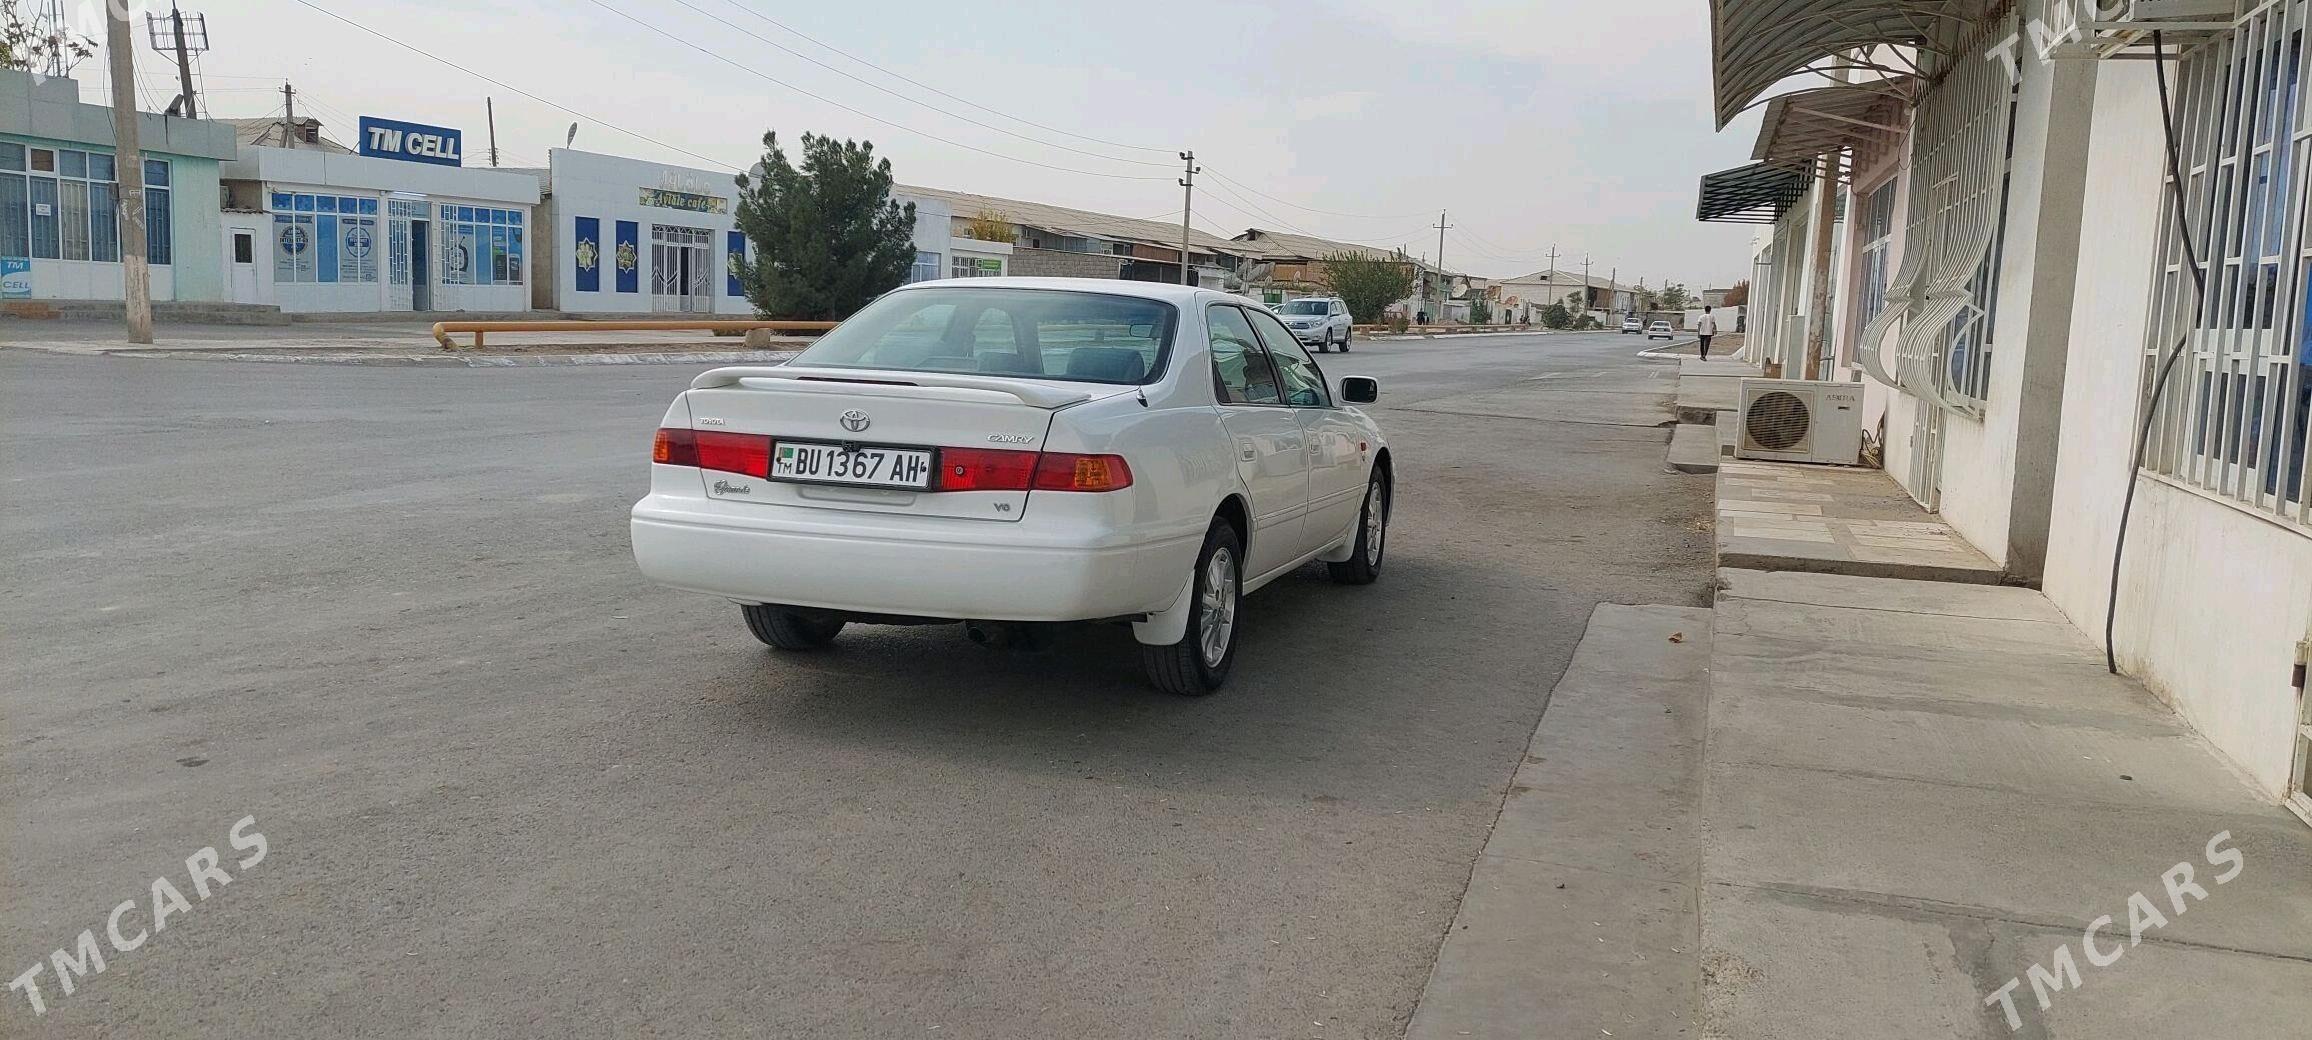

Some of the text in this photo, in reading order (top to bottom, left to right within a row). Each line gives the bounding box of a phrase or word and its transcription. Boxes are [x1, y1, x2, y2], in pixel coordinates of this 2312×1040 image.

[368, 126, 459, 160] TM CELL
[7, 261, 24, 269] TM
[3, 281, 29, 289] CELL
[986, 433, 1034, 444] CAMRY
[777, 461, 792, 474] TM
[795, 448, 920, 483] BU 1367 AH
